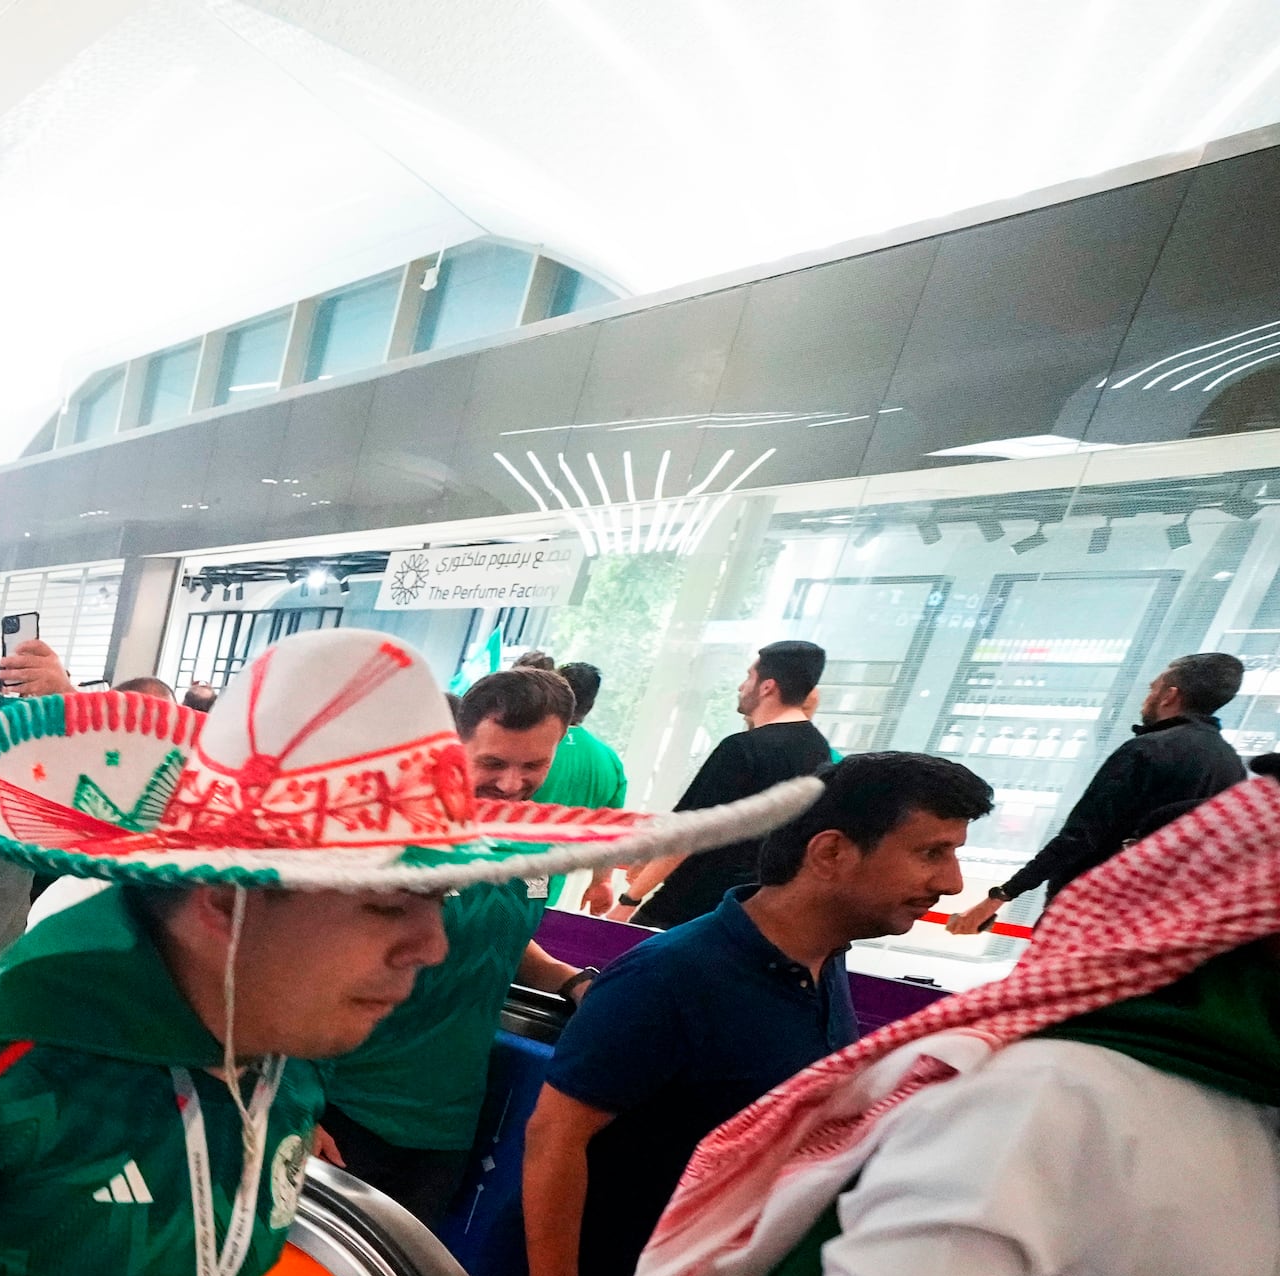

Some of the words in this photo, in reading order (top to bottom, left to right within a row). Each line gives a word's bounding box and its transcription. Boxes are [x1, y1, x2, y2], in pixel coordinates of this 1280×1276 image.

[429, 586, 449, 600] The
[452, 584, 506, 599] Perfume
[509, 583, 559, 600] Factory
